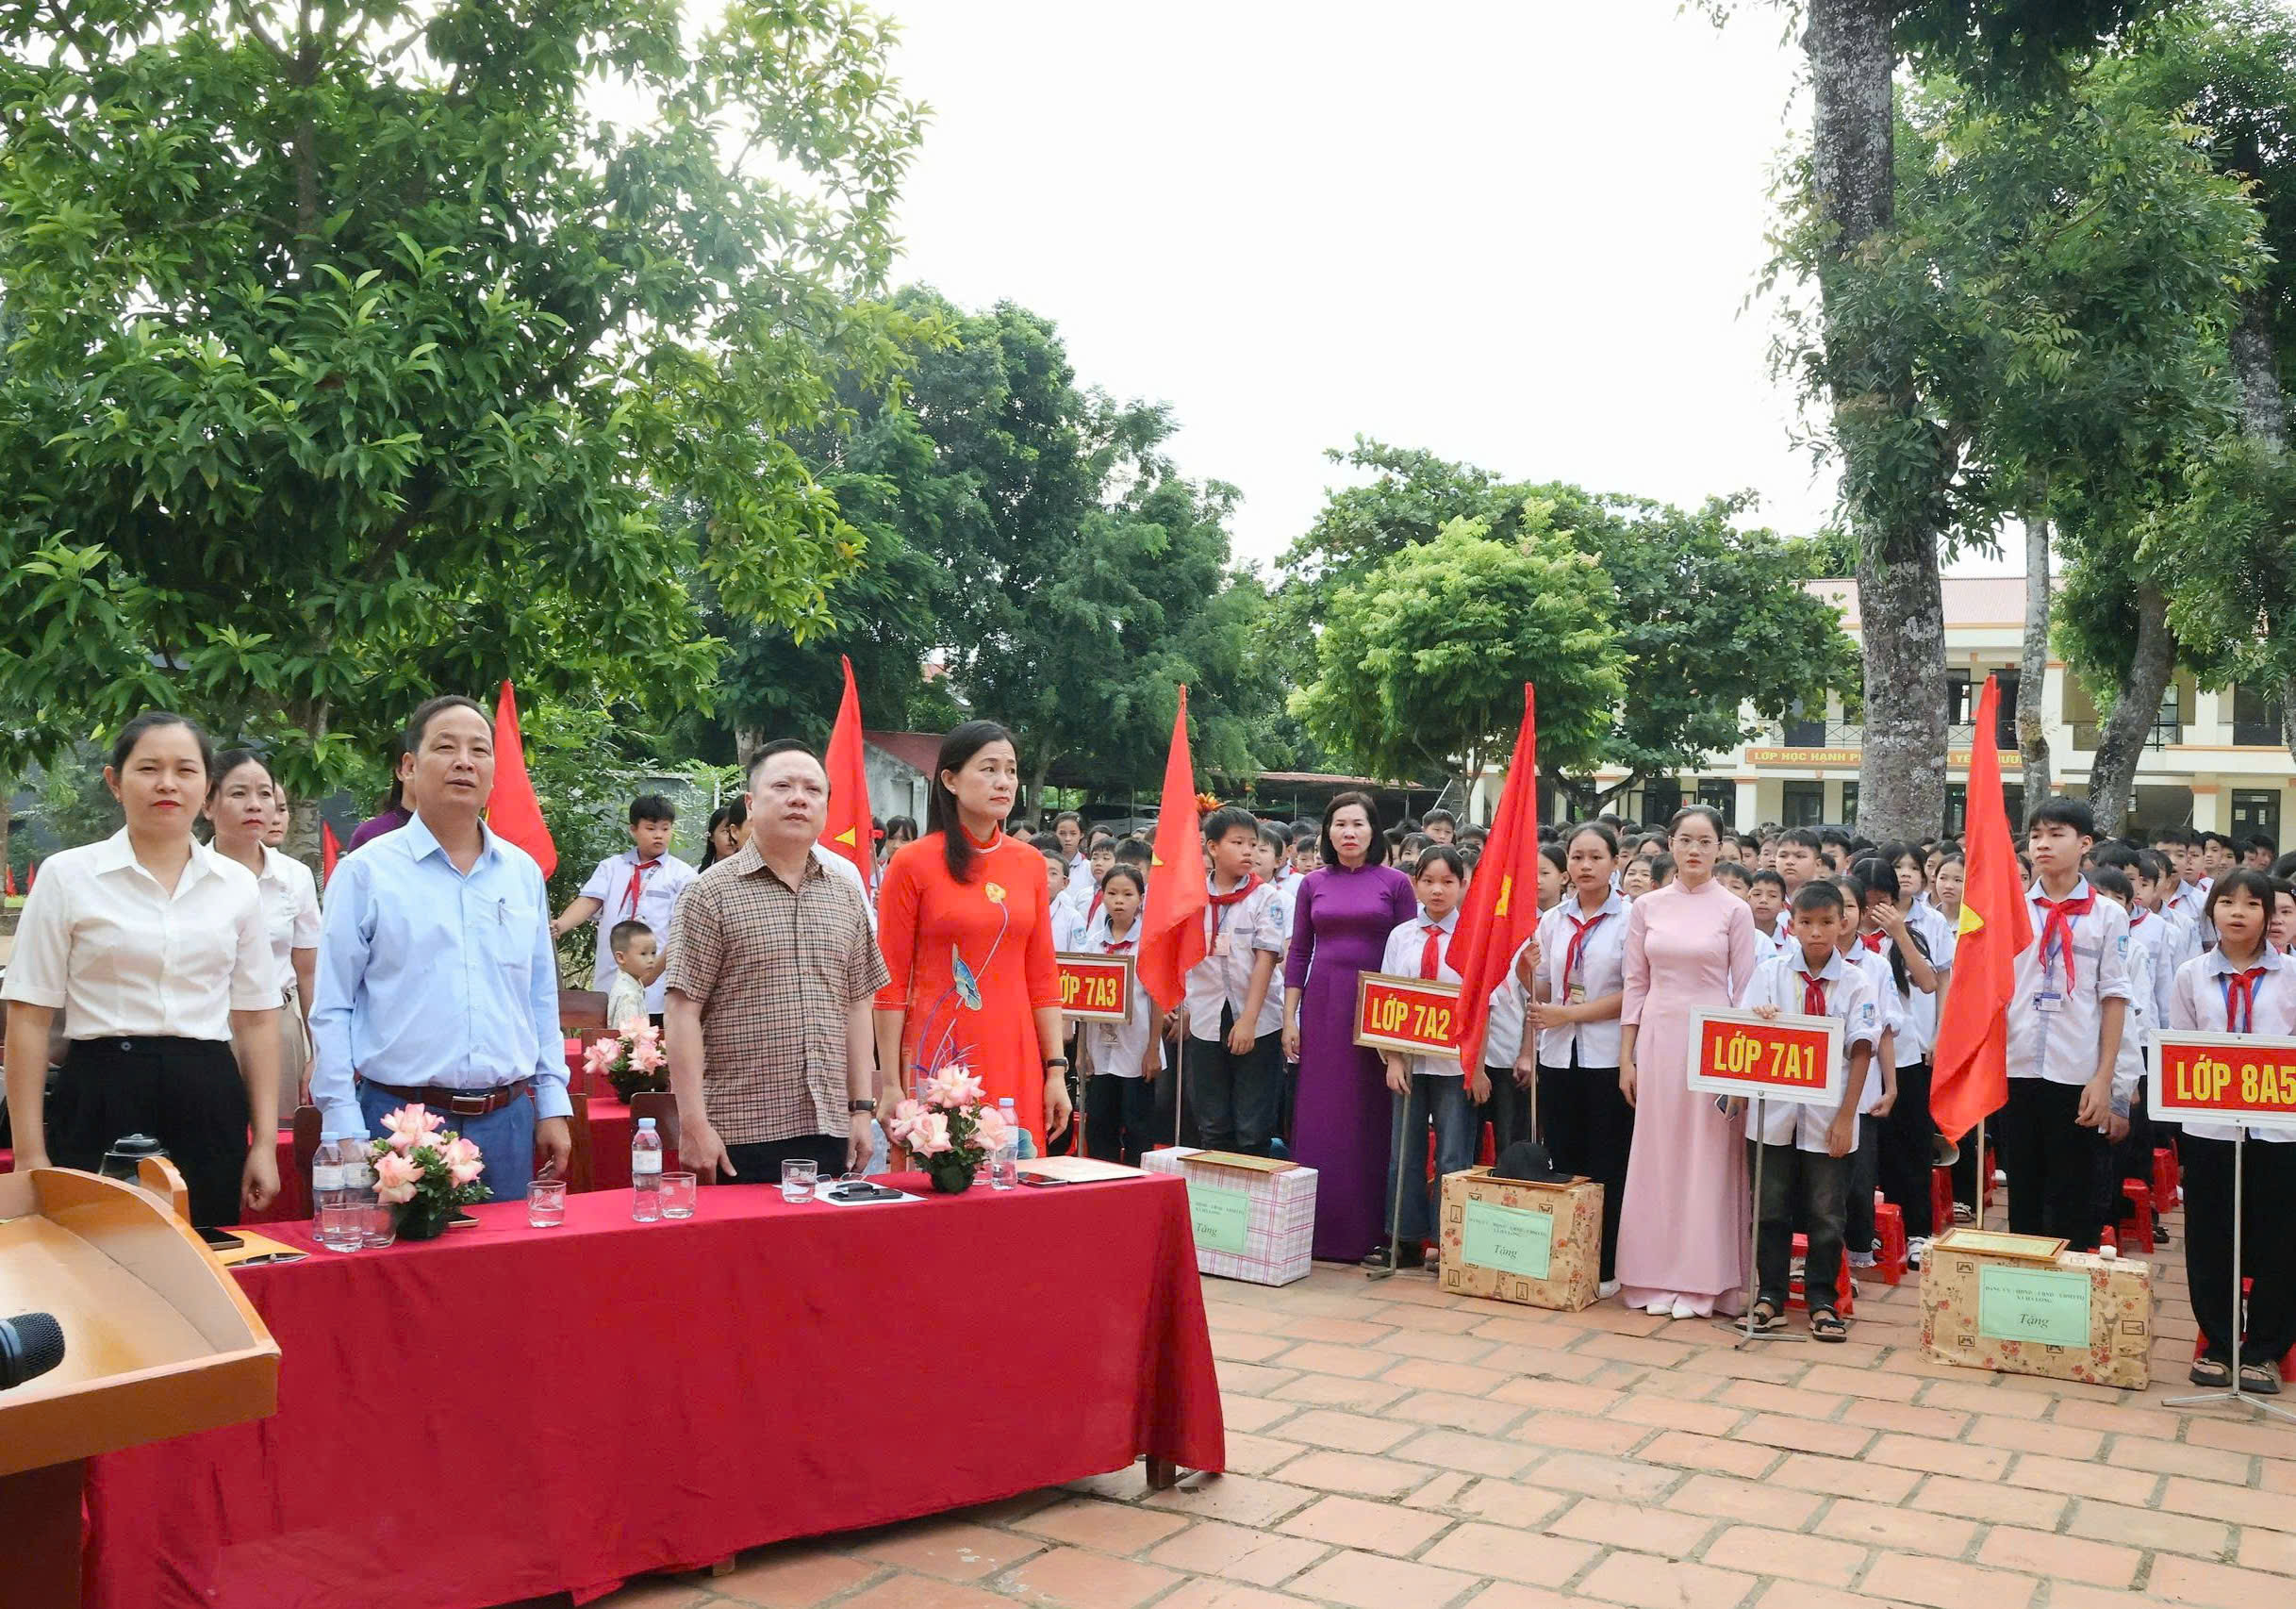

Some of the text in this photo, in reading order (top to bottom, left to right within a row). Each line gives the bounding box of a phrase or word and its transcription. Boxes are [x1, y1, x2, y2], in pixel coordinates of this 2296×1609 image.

[1059, 970, 1117, 1007] ỚP 7A3
[1371, 993, 1451, 1041] LỚP 7A2
[1713, 1030, 1815, 1081] LỚP 7A1
[2176, 1053, 2296, 1105] LỚP 8A5
